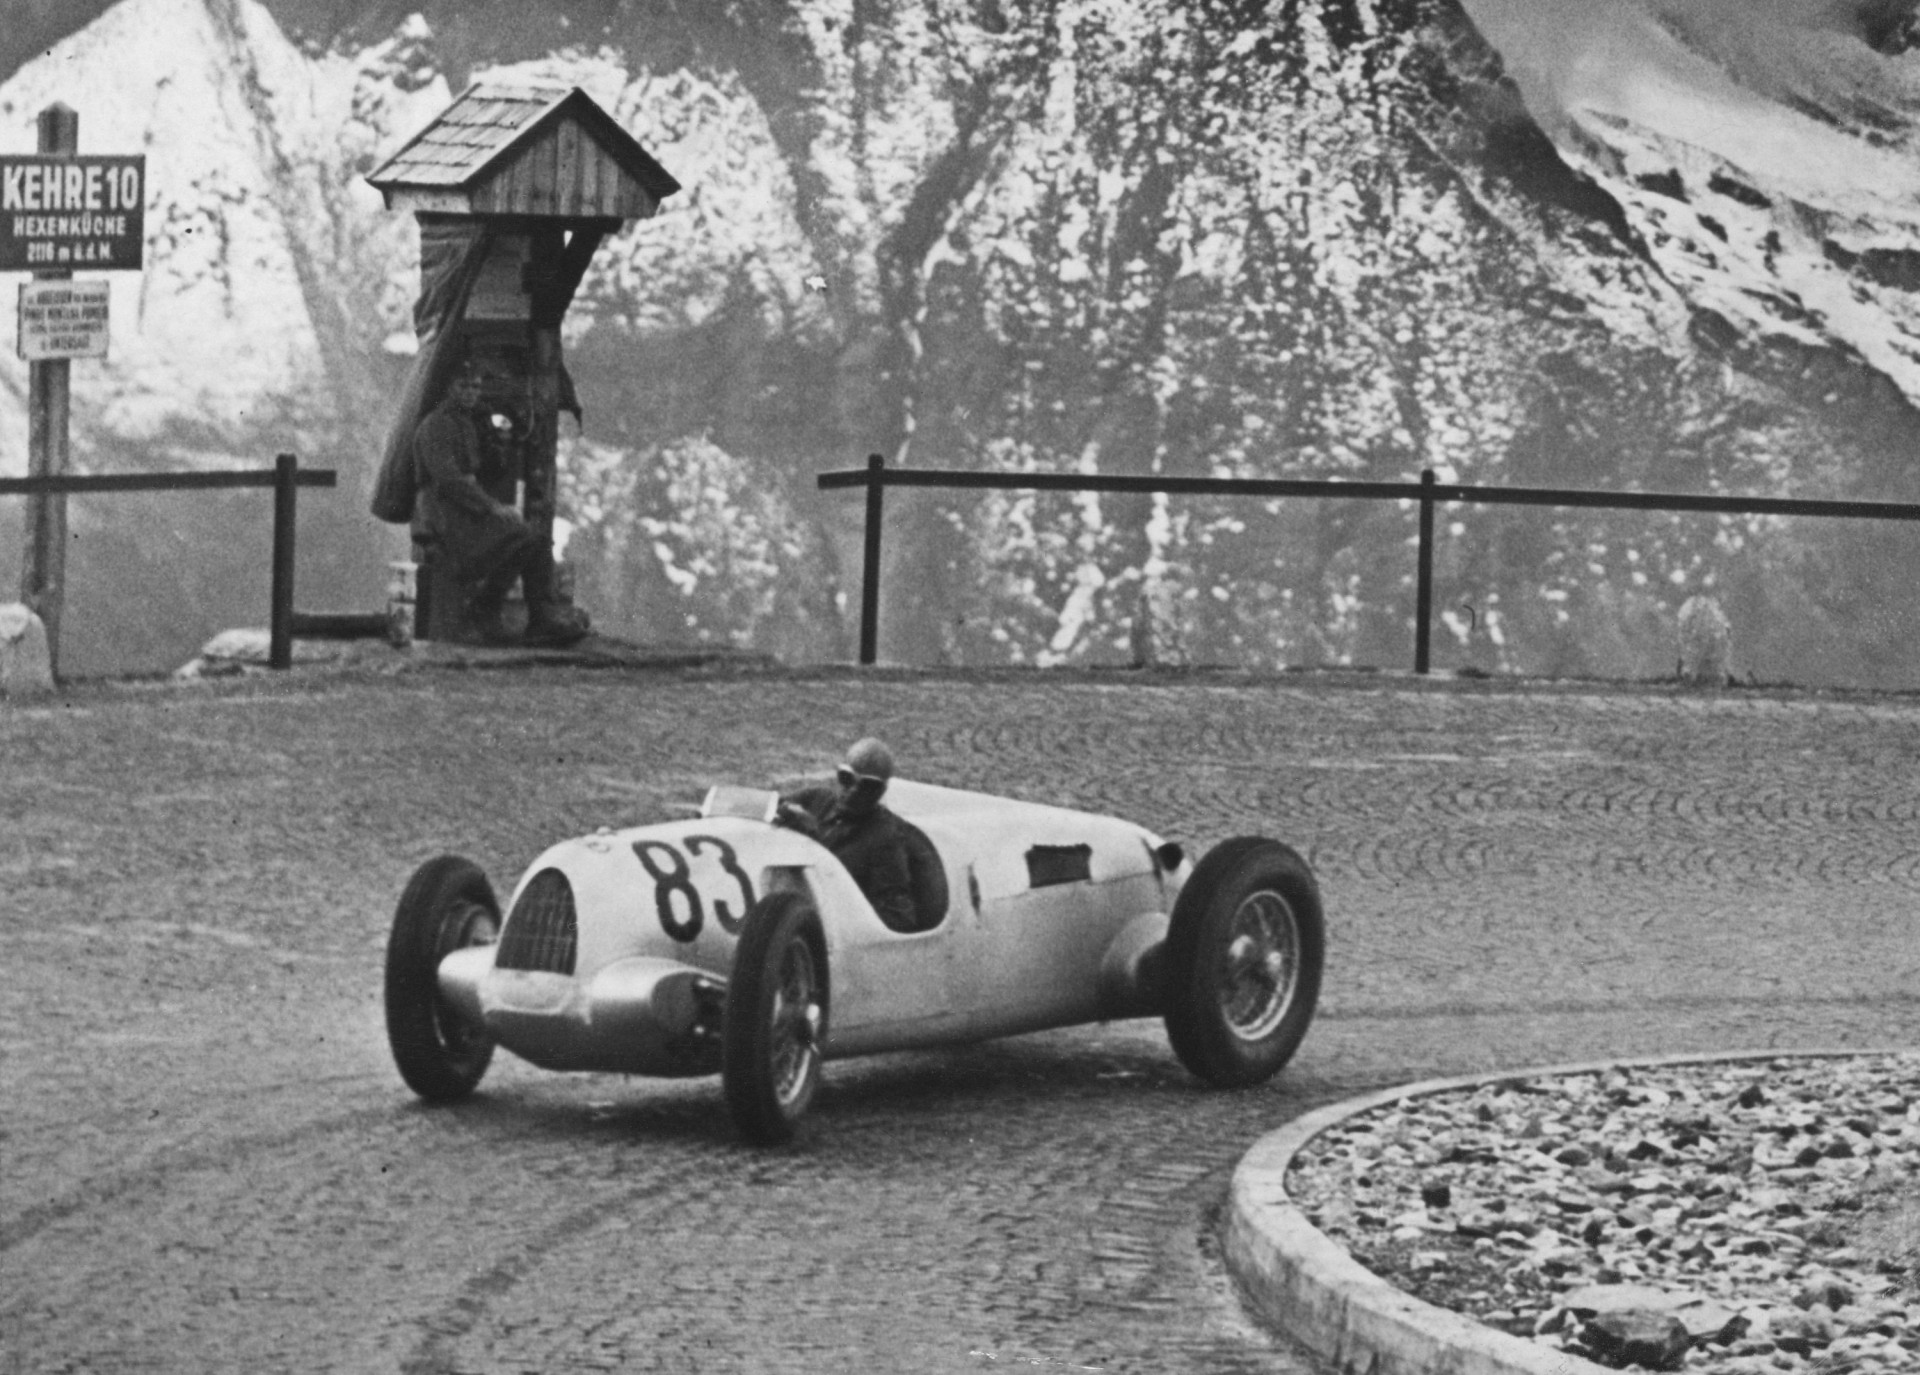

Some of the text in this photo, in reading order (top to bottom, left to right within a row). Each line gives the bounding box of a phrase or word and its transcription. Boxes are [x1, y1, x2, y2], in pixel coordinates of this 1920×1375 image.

[3, 165, 139, 210] KEHRE 10
[13, 212, 126, 237] HEXENKÜCHE
[632, 835, 756, 943] 83
